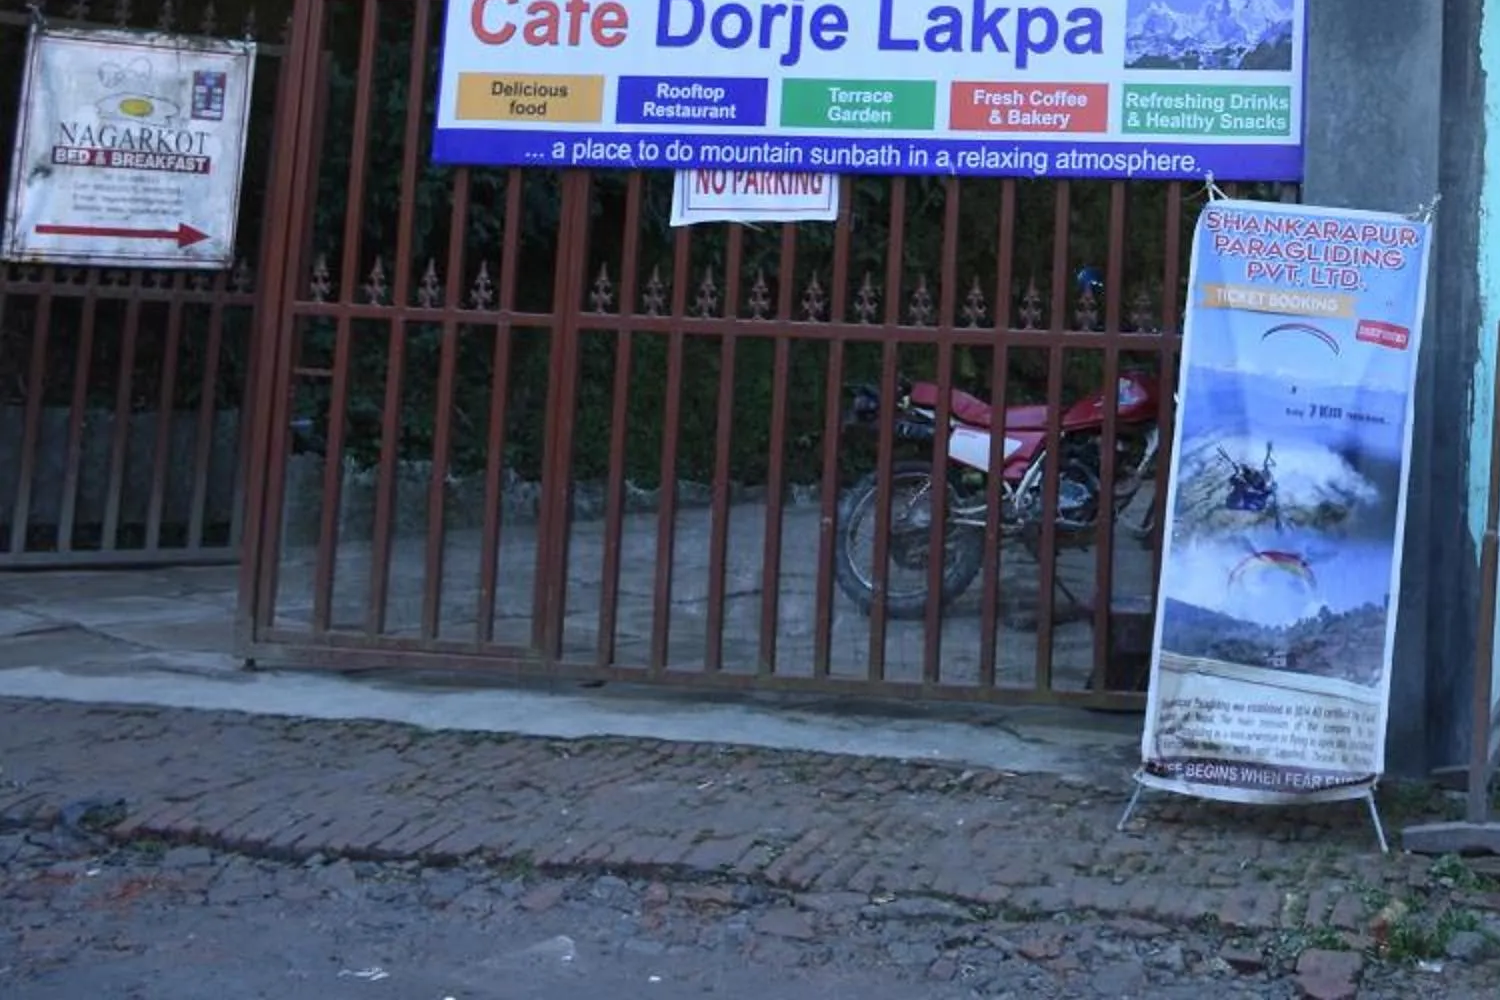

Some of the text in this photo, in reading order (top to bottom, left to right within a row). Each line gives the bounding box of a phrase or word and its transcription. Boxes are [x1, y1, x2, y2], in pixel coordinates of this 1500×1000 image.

[491, 80, 568, 99] Delicious
[656, 82, 726, 101] Rooftop
[828, 86, 894, 105] Terrace
[972, 89, 1089, 108] Fresh Coffee
[509, 99, 548, 116] food
[642, 101, 737, 120] Restaurant
[1126, 92, 1289, 115] Refreshing Drinks
[827, 105, 893, 124] Garden
[988, 109, 1071, 129] & Bakery
[1126, 112, 1287, 133] & Healthy Snacks
[60, 122, 211, 155] NAGARKOT
[54, 147, 208, 173] BED & BREAKFAST
[552, 142, 565, 160] a
[572, 138, 632, 166] place
[638, 141, 659, 162] to
[665, 139, 694, 162] do
[700, 142, 803, 165] mountain
[809, 144, 901, 168] sunbath
[908, 145, 928, 167] in
[935, 150, 949, 168] a
[957, 146, 1048, 175] relaxing
[1055, 150, 1201, 176] atmosphere.
[695, 168, 823, 195] NO PARKING
[1206, 210, 1418, 247] SHANKARAPUR
[1214, 234, 1405, 268] PARAGLIDING
[1311, 266, 1364, 287] LTD.
[1215, 288, 1339, 312] TICKET BOOKING
[1185, 763, 1238, 782] BEGINS
[1240, 767, 1281, 785] WHEN
[1285, 773, 1321, 789] FEAR
